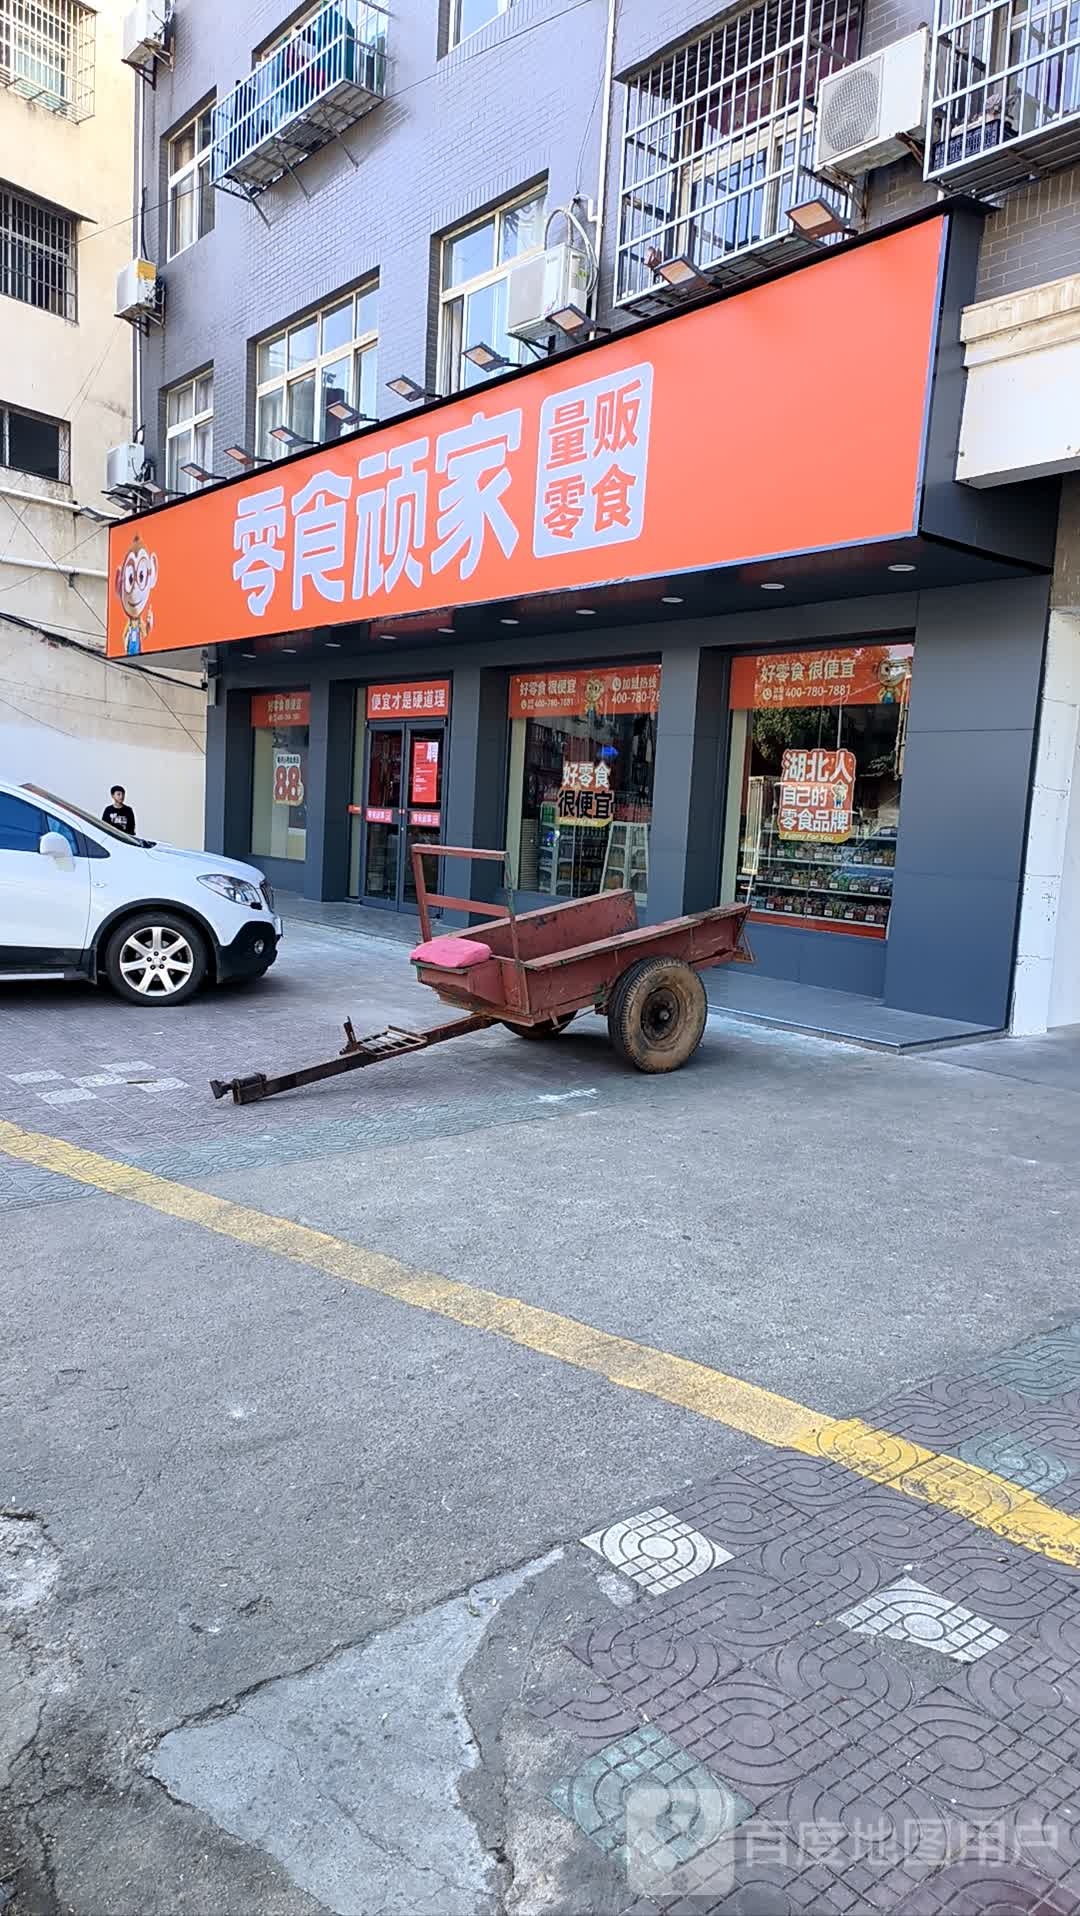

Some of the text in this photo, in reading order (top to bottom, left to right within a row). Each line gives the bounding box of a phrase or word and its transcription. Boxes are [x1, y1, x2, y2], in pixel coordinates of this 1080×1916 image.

[546, 378, 642, 470] 量贩
[233, 408, 522, 617] 零食顽家
[543, 464, 637, 539] 零食
[761, 657, 856, 684] 好零食 很便宜
[371, 688, 446, 711] 便宜才是硬道理
[519, 677, 577, 697] 好零食 很便宜
[785, 684, 851, 698] 400-780-7881
[561, 761, 611, 790] 好零食
[783, 751, 853, 783] 湖北人
[275, 765, 300, 801] 88
[782, 785, 827, 807] 自己的
[558, 790, 613, 819] 很便宜
[780, 808, 849, 833] 零食品牌
